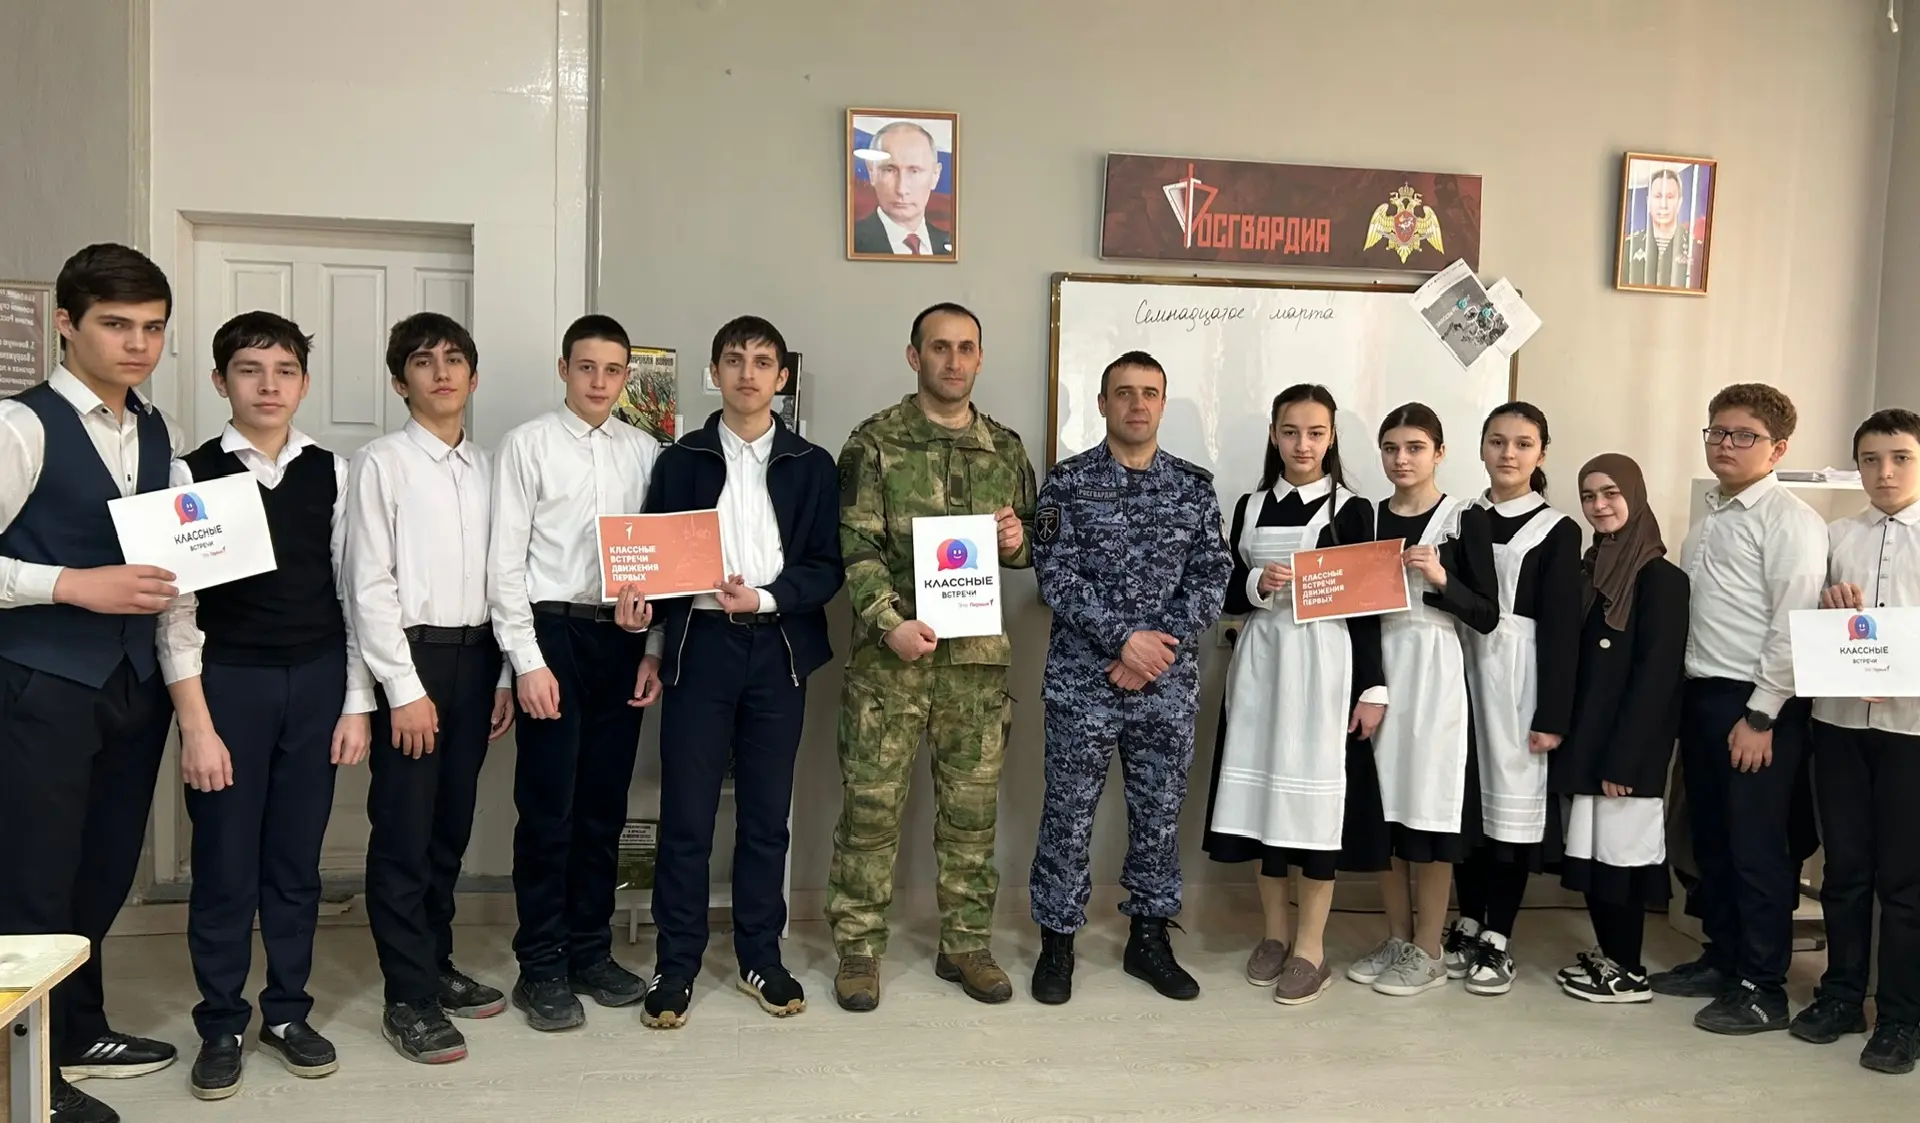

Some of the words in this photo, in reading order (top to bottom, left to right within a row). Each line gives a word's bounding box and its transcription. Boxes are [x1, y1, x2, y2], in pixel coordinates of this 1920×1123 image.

[1269, 306, 1335, 331] марта
[174, 524, 222, 544] КЛАССНЫЕ
[609, 545, 656, 554] КЛАССНЫЕ
[610, 555, 649, 563] ВСТРЕЧИ
[612, 564, 659, 573] ДВИЖЕНИЯ
[612, 573, 646, 582] ПЕРВЫХ
[1302, 569, 1344, 582] КЛАССНЫЕ
[924, 576, 994, 588] КЛАССНЫЕ
[1302, 579, 1336, 590] ВСТРЕЧИ
[942, 590, 977, 599] ВСТРЕЧИ
[1302, 585, 1345, 597] ДВИЖЕНИЯ
[1303, 596, 1333, 606] ПЕРВЫХ
[1840, 646, 1889, 655] КЛАССНЫЕ
